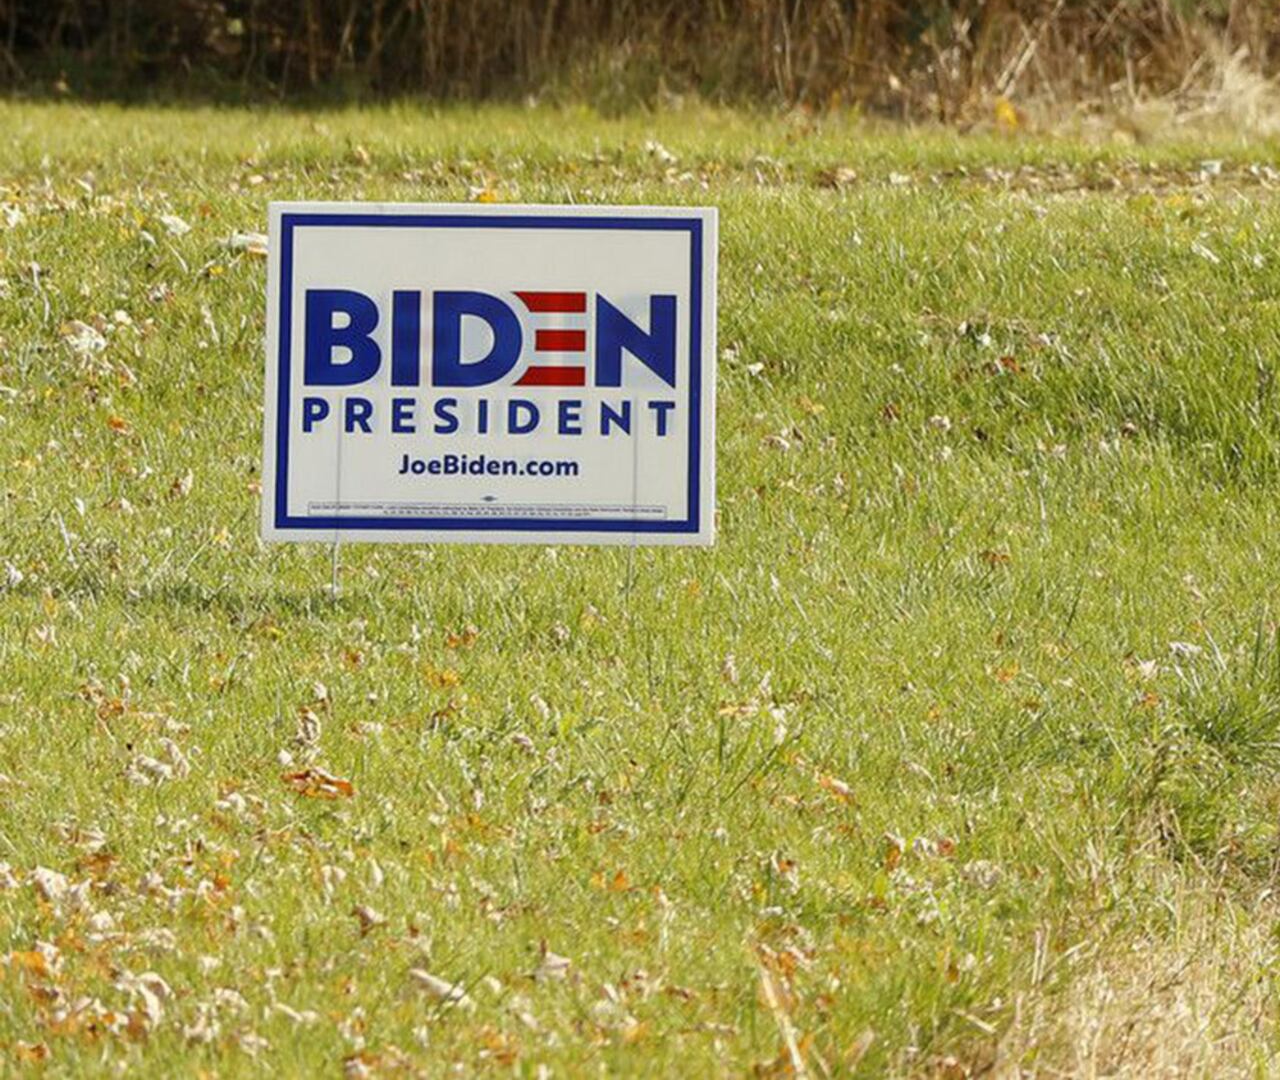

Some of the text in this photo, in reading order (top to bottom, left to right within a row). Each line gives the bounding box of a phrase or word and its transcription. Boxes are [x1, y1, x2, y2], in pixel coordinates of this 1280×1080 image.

[303, 288, 678, 390] BIDEN
[302, 396, 677, 438] PRESIDENT
[398, 453, 580, 477] JoeBiden.com
